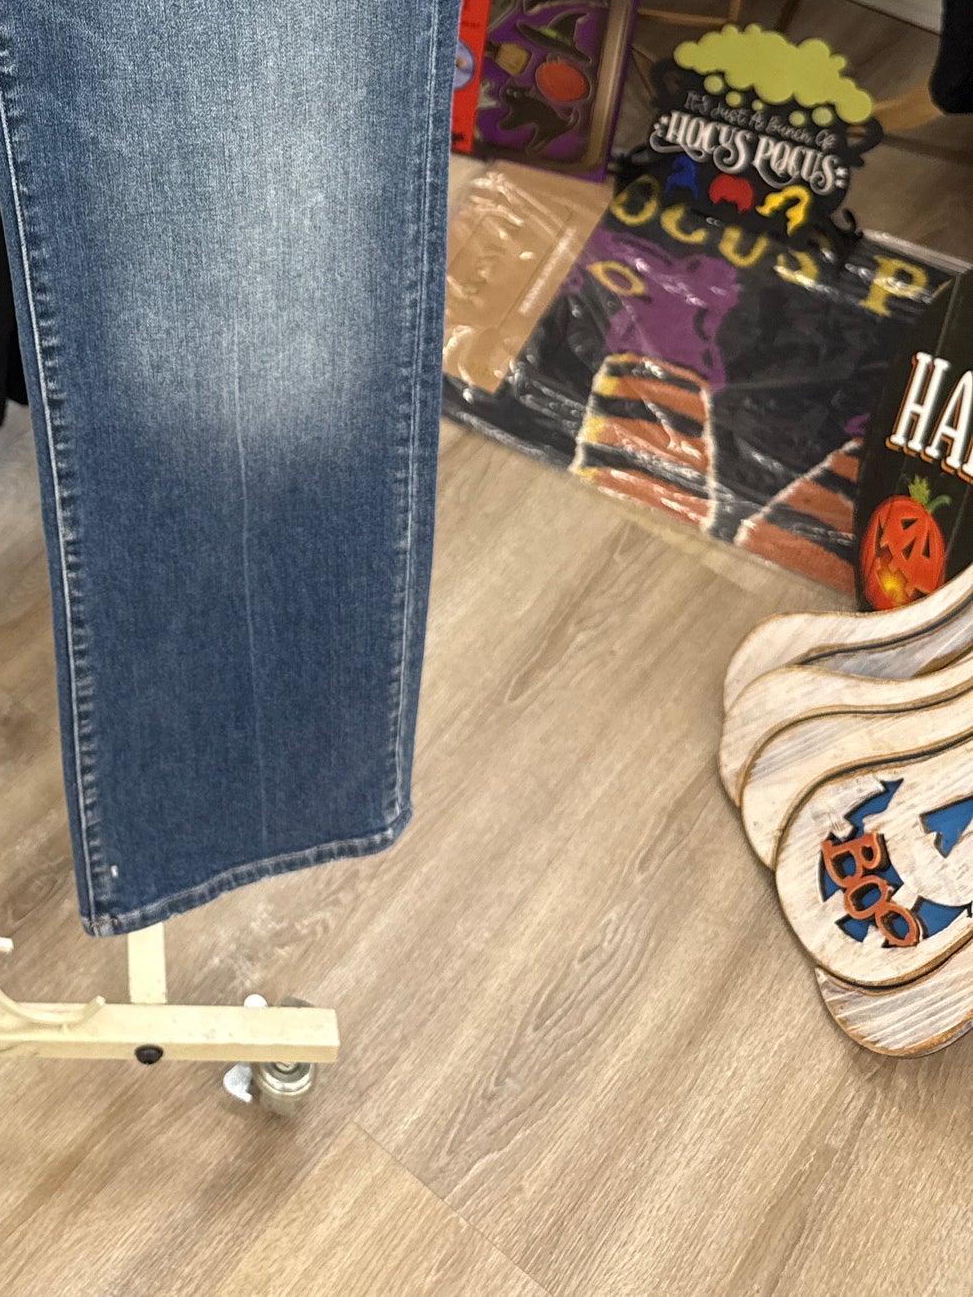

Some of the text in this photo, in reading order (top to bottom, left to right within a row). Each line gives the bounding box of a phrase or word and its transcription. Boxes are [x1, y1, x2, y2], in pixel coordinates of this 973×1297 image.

[650, 110, 838, 196] HOCUS POCUS
[885, 351, 973, 486] HA
[821, 832, 920, 948] BOO
